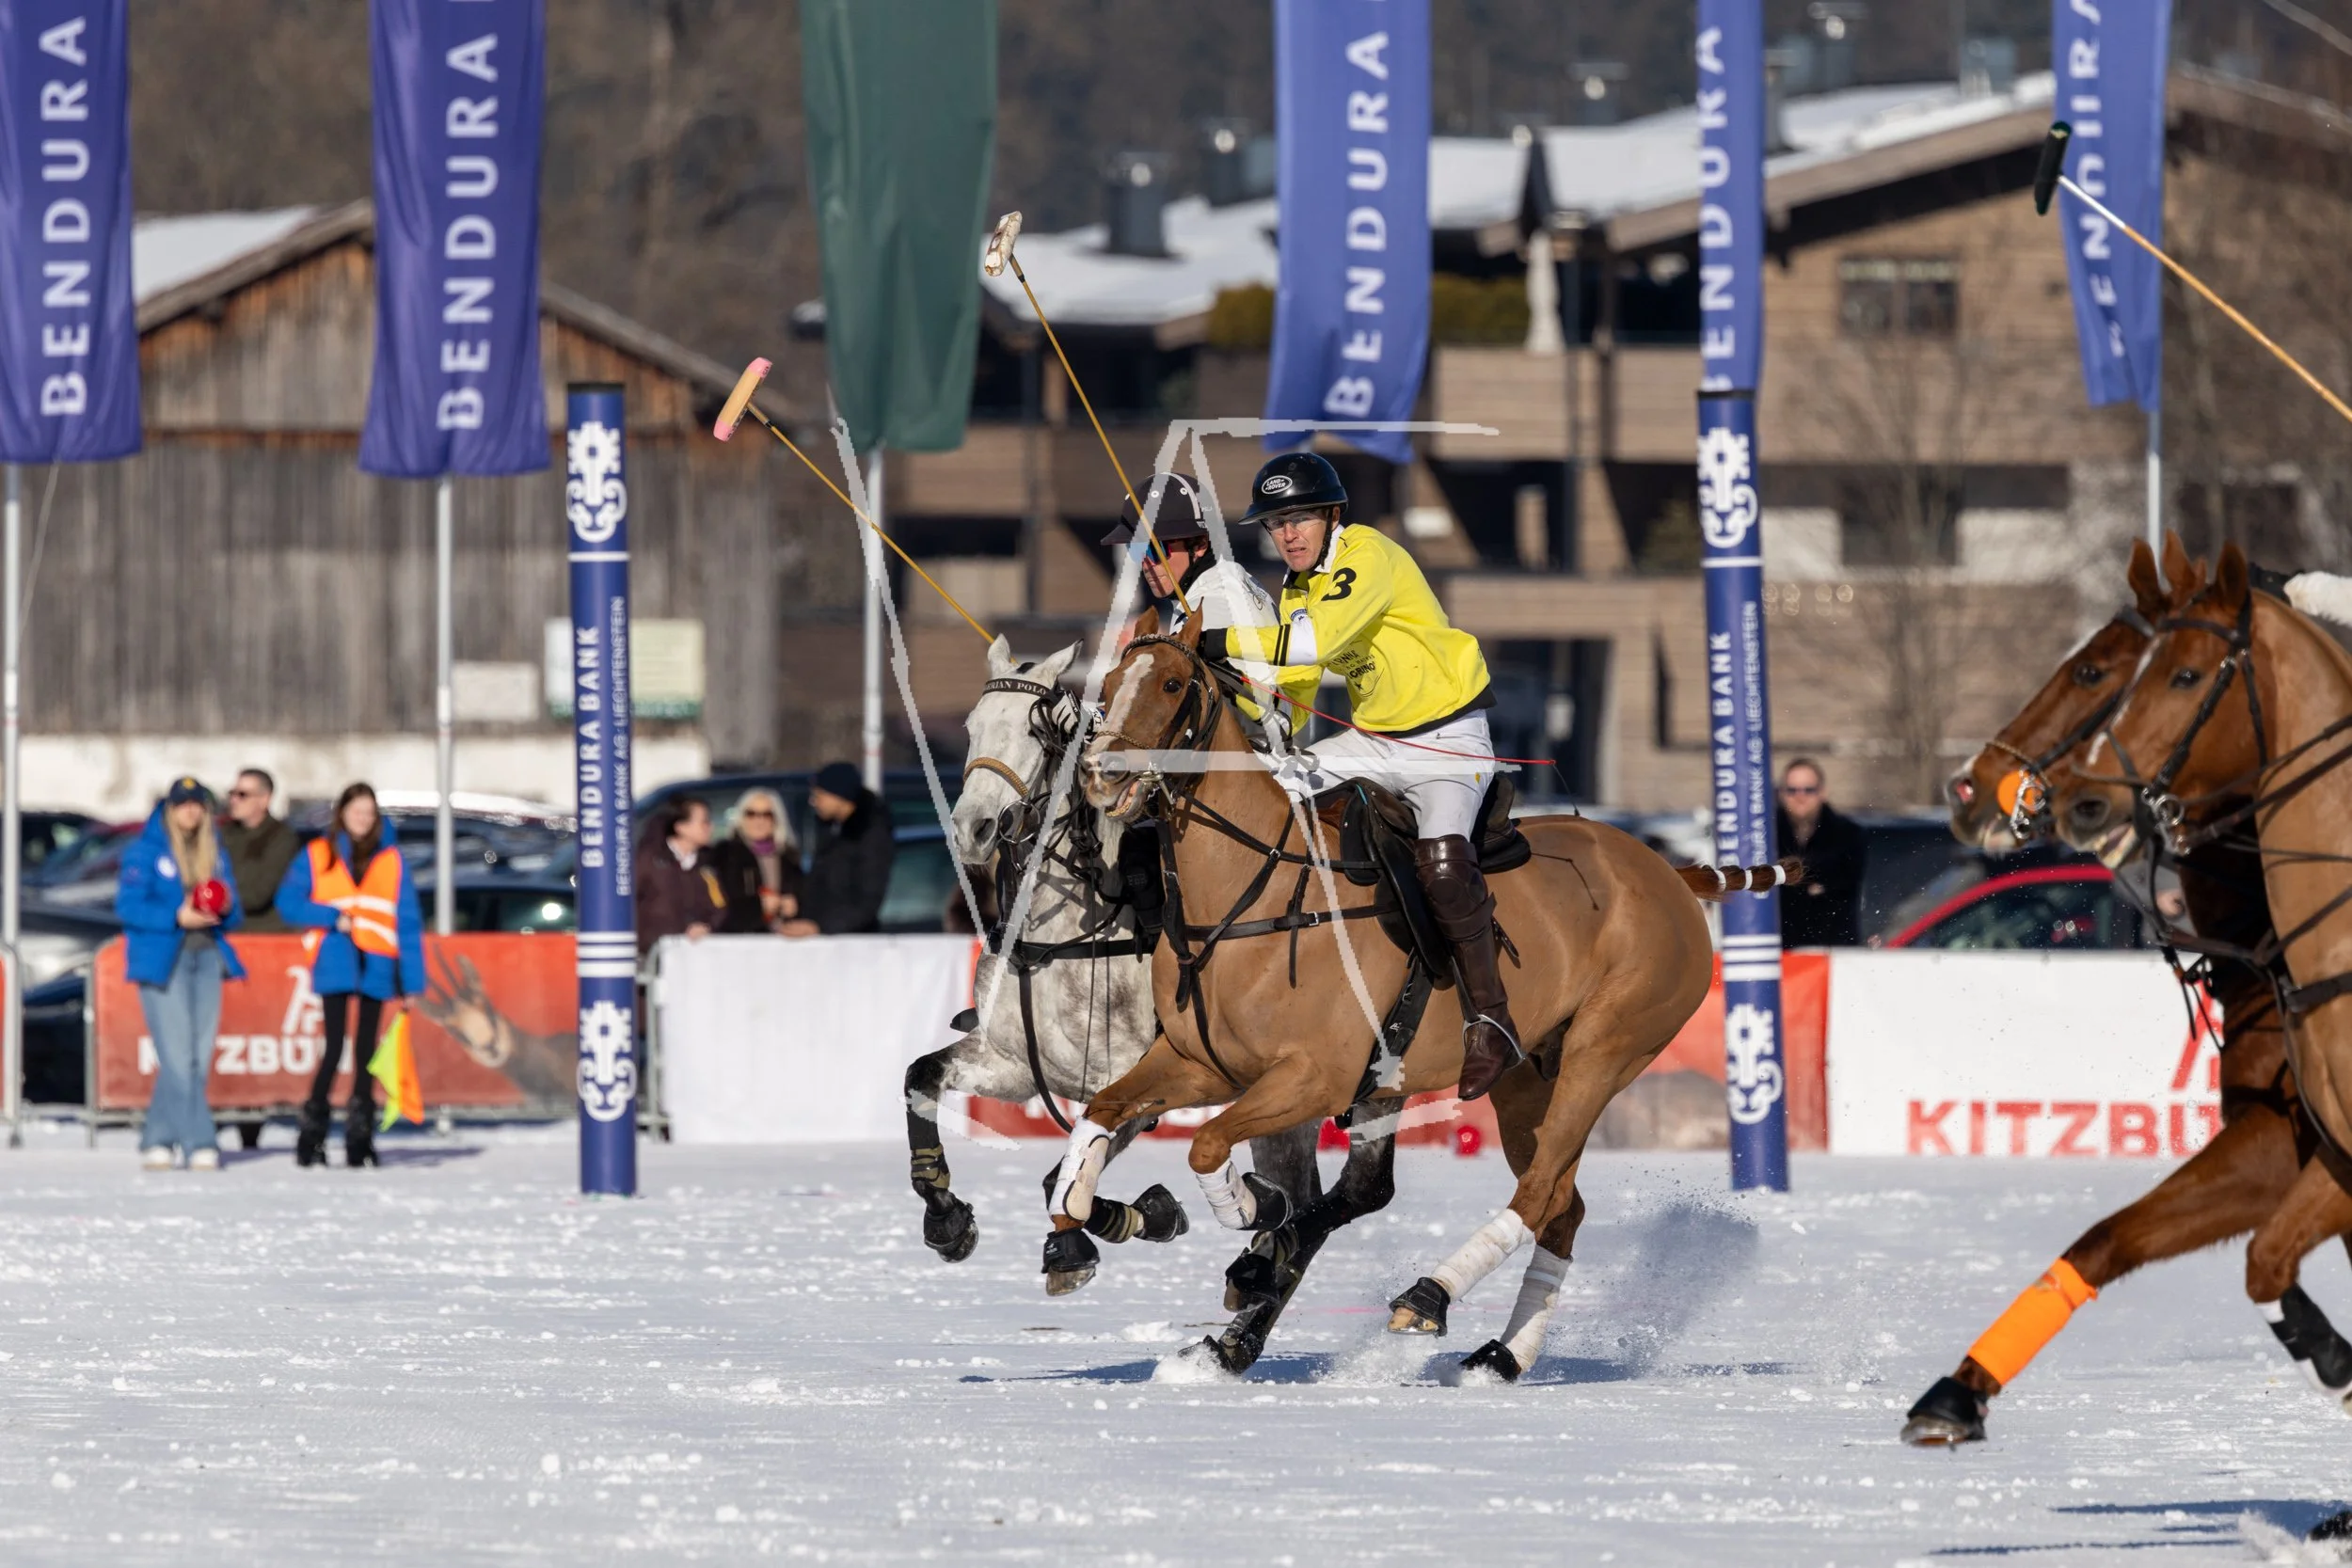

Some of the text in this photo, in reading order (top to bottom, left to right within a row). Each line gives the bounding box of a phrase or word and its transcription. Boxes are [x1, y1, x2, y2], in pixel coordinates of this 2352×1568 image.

[39, 16, 91, 416] BENDURA
[436, 33, 500, 431] BENDURA
[1324, 31, 1391, 420] BENDURA
[1016, 682, 1046, 696] POLO
[1321, 567, 1357, 602] 3
[1709, 631, 1734, 717] BANK
[576, 626, 604, 868] BENDURA BANK
